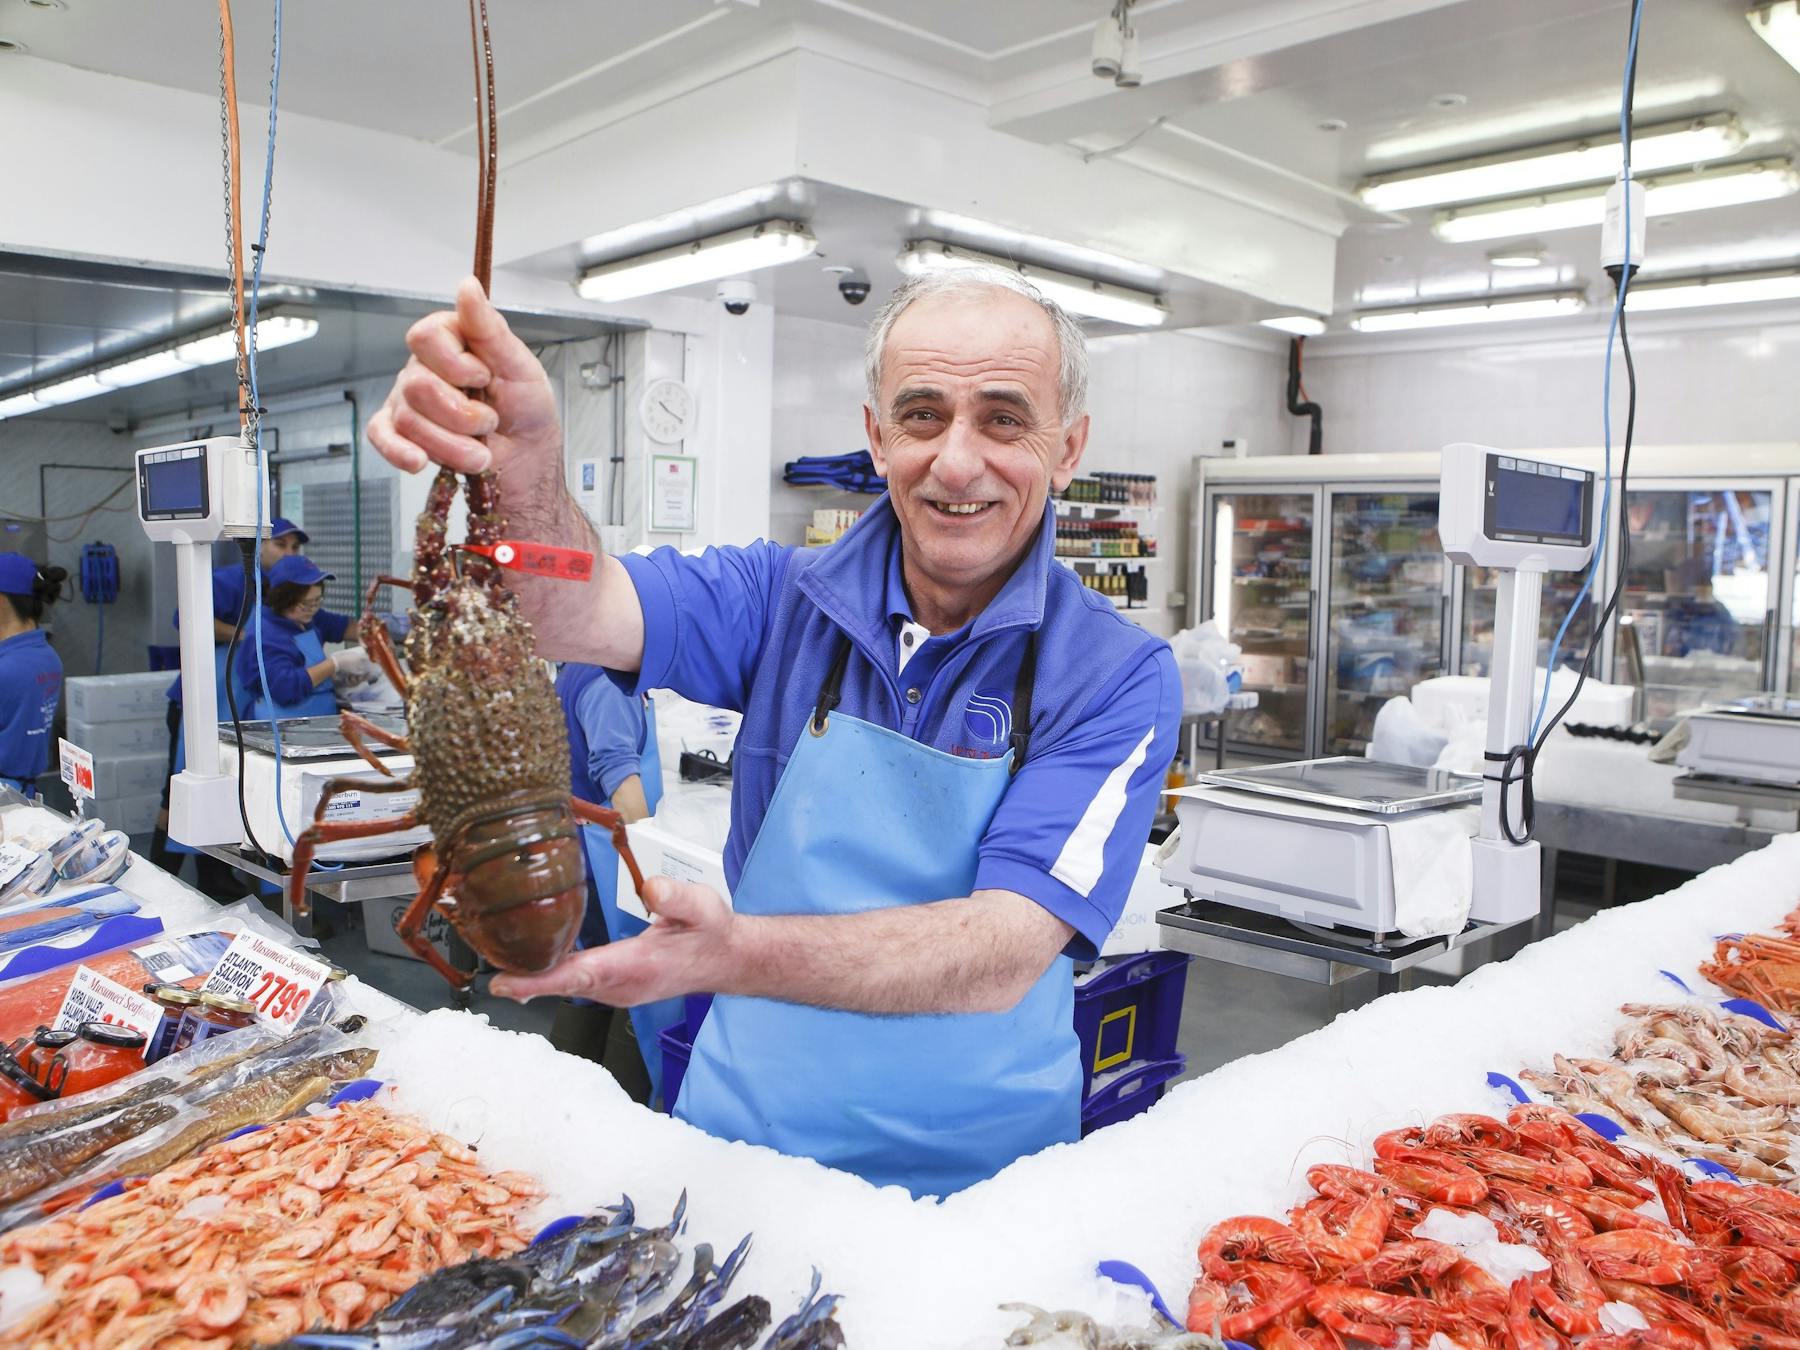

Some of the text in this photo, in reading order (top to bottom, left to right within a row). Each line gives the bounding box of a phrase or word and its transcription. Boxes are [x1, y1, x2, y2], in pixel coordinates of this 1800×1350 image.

[224, 951, 263, 977] ATLANTIC
[249, 939, 322, 980] Musumeci Seafoods
[215, 963, 255, 991] SALMON
[69, 987, 105, 1015] YARRA VALLEY
[88, 978, 127, 1005] Musumeci
[63, 1002, 87, 1022] SALMON
